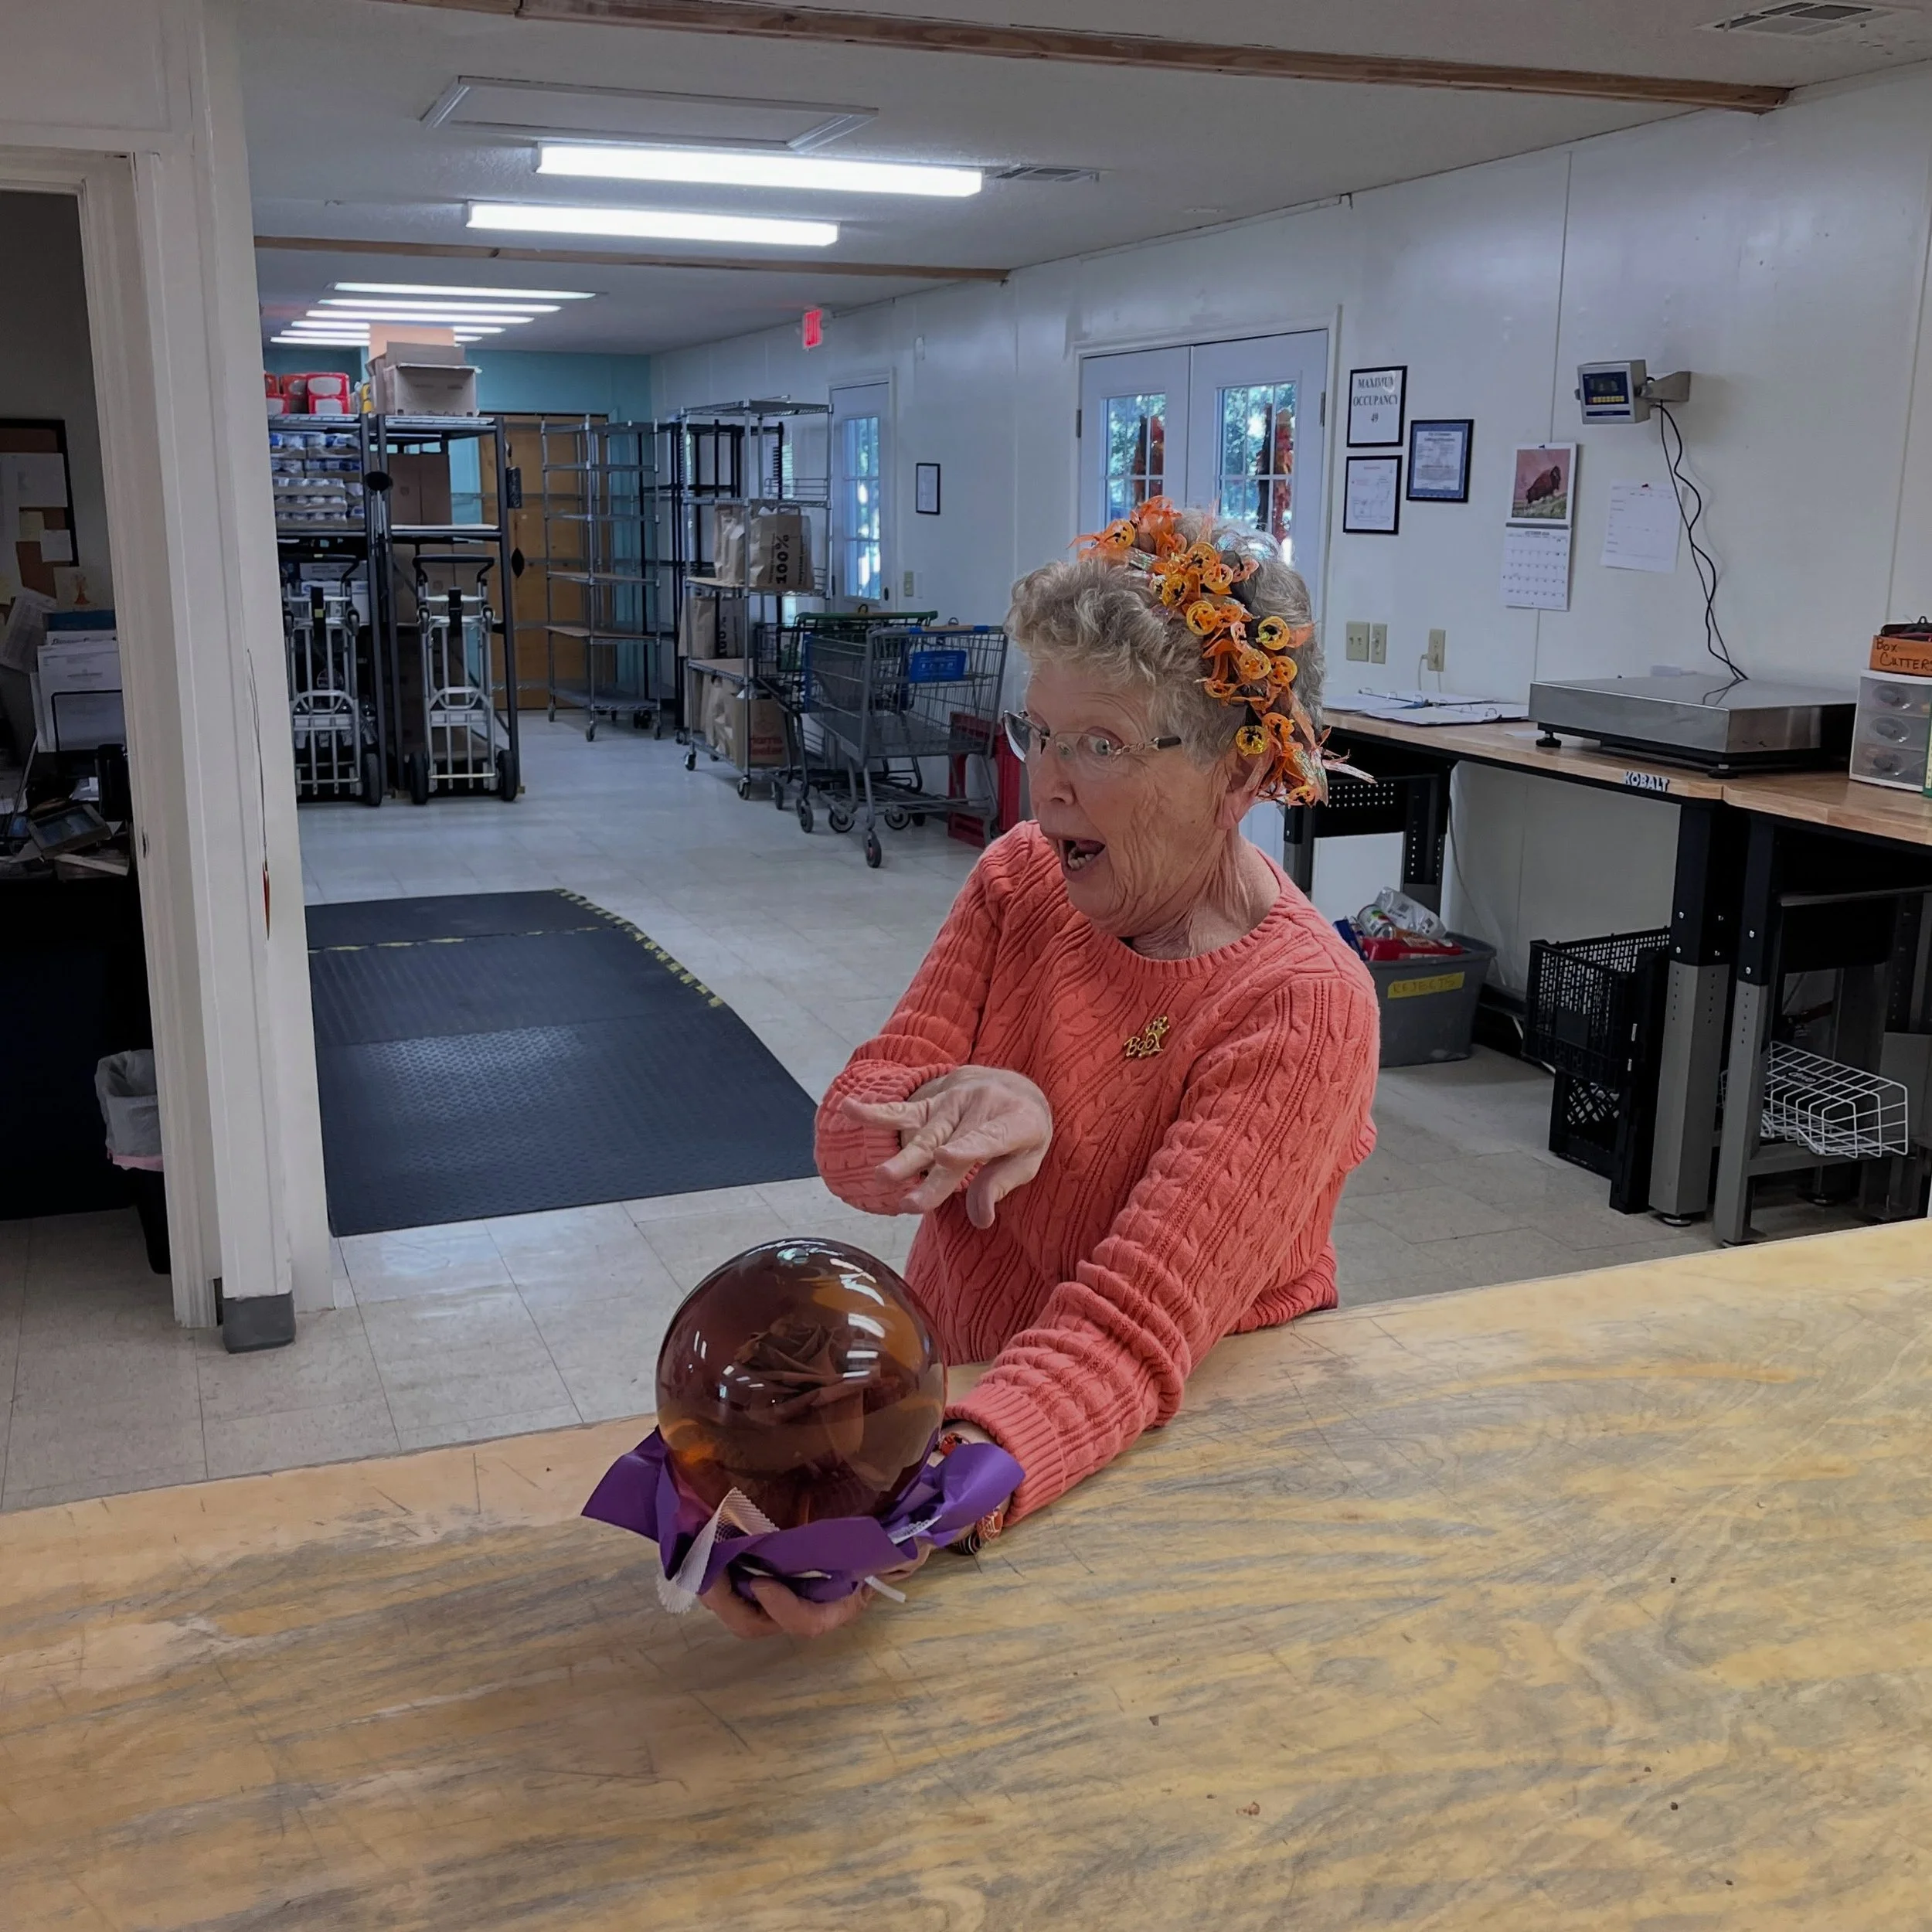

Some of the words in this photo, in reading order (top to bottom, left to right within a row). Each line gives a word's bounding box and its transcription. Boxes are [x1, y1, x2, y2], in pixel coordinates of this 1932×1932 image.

[1353, 394, 1398, 406] OCCUPANCY
[1371, 413, 1379, 423] 49
[776, 535, 789, 583] 100%
[1625, 770, 1670, 792] KOBALT
